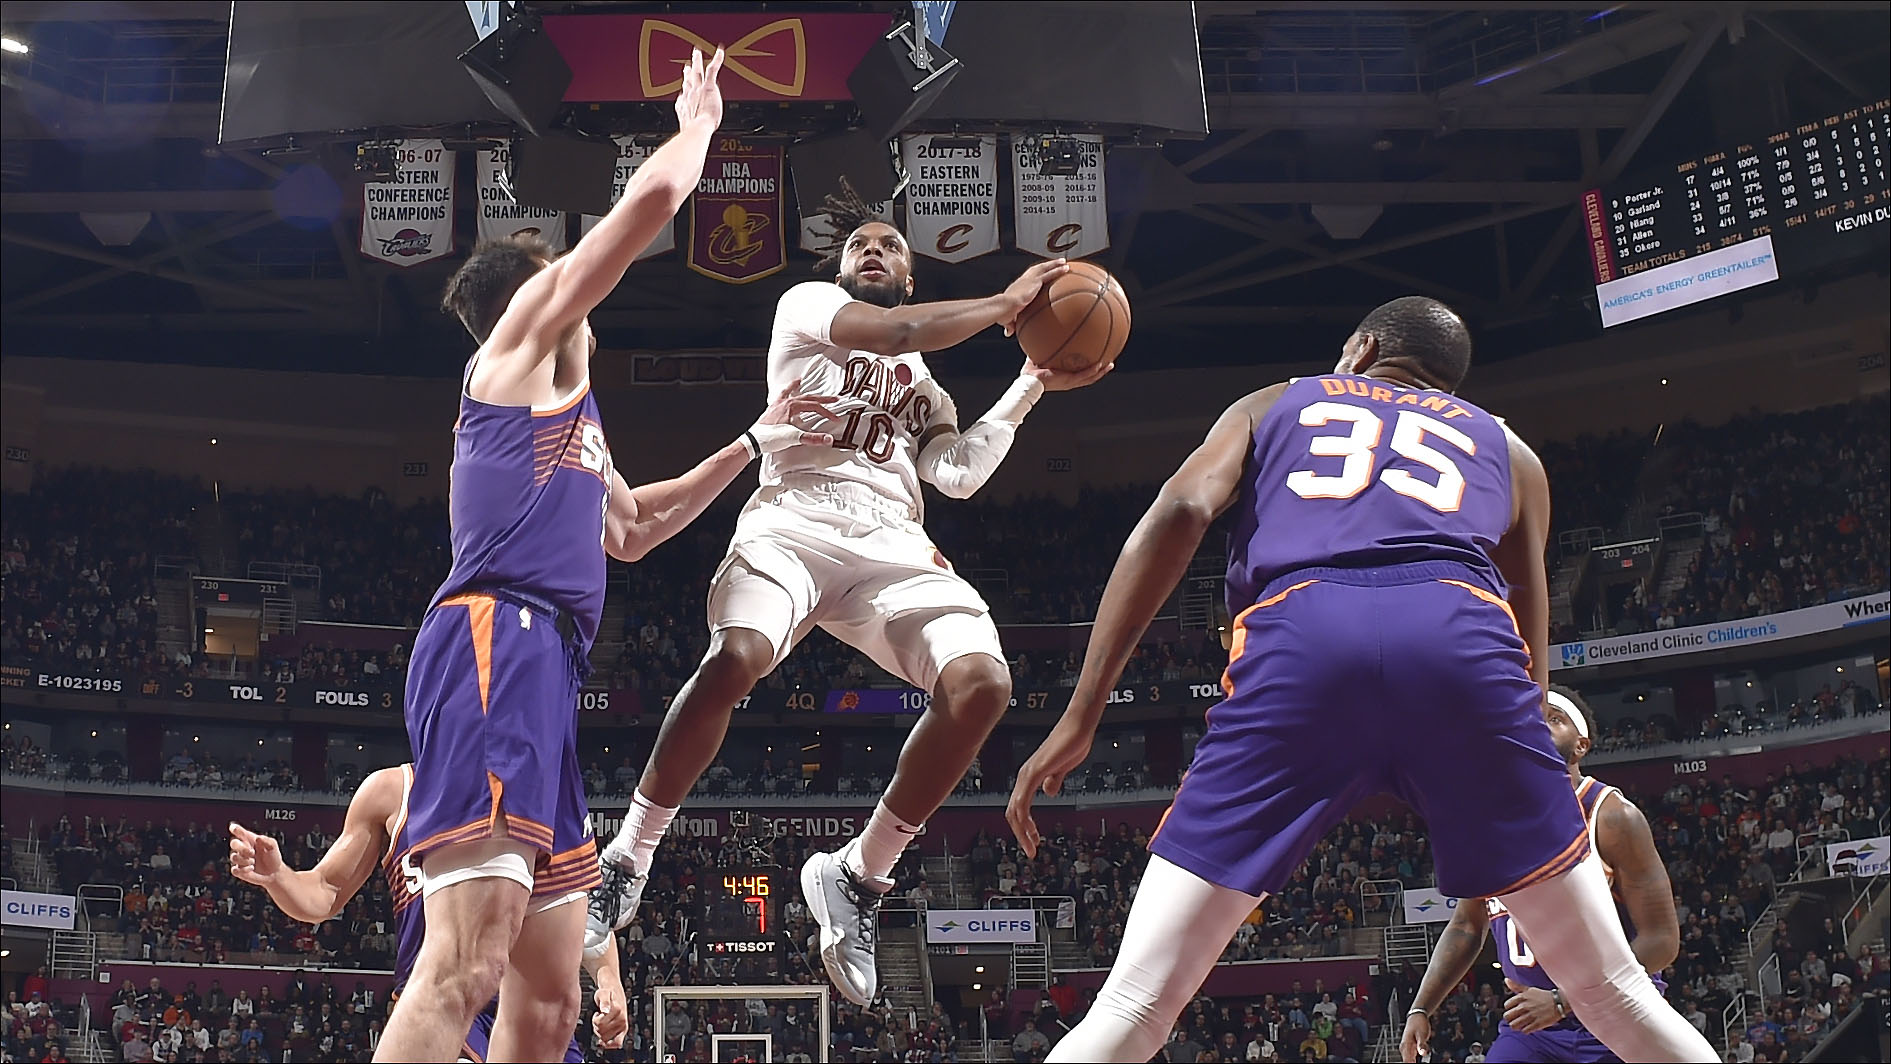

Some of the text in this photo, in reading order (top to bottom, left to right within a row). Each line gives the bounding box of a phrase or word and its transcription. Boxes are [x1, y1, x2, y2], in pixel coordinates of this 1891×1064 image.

[918, 145, 981, 158] 2017-18
[1080, 142, 1100, 153] SION
[399, 149, 442, 163] 06-07
[397, 171, 439, 184] STERN
[723, 163, 750, 178] NBA
[921, 166, 980, 179] EASTERN
[698, 178, 775, 194] CHAMPIONS
[1625, 190, 1651, 205] Porter
[1652, 186, 1664, 197] Jr.
[1685, 175, 1696, 185] 17
[1737, 155, 1760, 169] 100%
[368, 187, 450, 202] CONFERENCE
[910, 183, 992, 197] CONFERENCE
[1613, 212, 1623, 222] 10
[1627, 200, 1661, 217] Garland
[1687, 188, 1698, 199] 31
[1710, 178, 1732, 192] 10/14
[1740, 169, 1760, 182] 71%
[371, 206, 446, 221] CHAMPIONS
[484, 204, 558, 219] CHAMPIONS
[914, 202, 990, 215] CHAMPIONS
[1617, 236, 1627, 246] 31
[1632, 229, 1654, 242] Allen
[1746, 194, 1765, 207] 71%
[1630, 215, 1654, 230] Niang
[1835, 212, 1872, 233] KEVIN
[1634, 240, 1661, 254] Okoro
[1695, 225, 1706, 236] 34
[1621, 260, 1648, 275] TEAM
[1649, 249, 1686, 267] TOTALS
[1602, 286, 1653, 310] AMERICA'S
[1656, 274, 1695, 295] ENERGY
[1319, 378, 1472, 419] DURANT
[834, 408, 896, 464] 10
[1286, 401, 1477, 512] 35
[1601, 544, 1650, 559] 203 204
[201, 581, 277, 594] 230 231
[1588, 622, 1777, 659] Cleveland Clinic Children's
[38, 674, 122, 692] E-1023195
[176, 682, 193, 698] -3
[1190, 684, 1222, 698] TOL
[230, 686, 286, 702] TOL 2
[315, 691, 392, 708] FOULS 3
[577, 693, 609, 710] 105
[899, 692, 932, 709] 108
[1027, 692, 1048, 709] 57
[1150, 686, 1160, 701] 3
[786, 696, 816, 711] 4Q
[1673, 761, 1707, 775] M103
[265, 809, 296, 821] M126
[763, 816, 855, 836] GENDS
[1860, 864, 1889, 874] IFFS
[724, 876, 769, 896] 4:46
[7, 902, 70, 918] CLIFFS
[744, 898, 765, 934] 7
[968, 920, 1032, 932] CLIFFS
[726, 941, 775, 952] TISSOT
